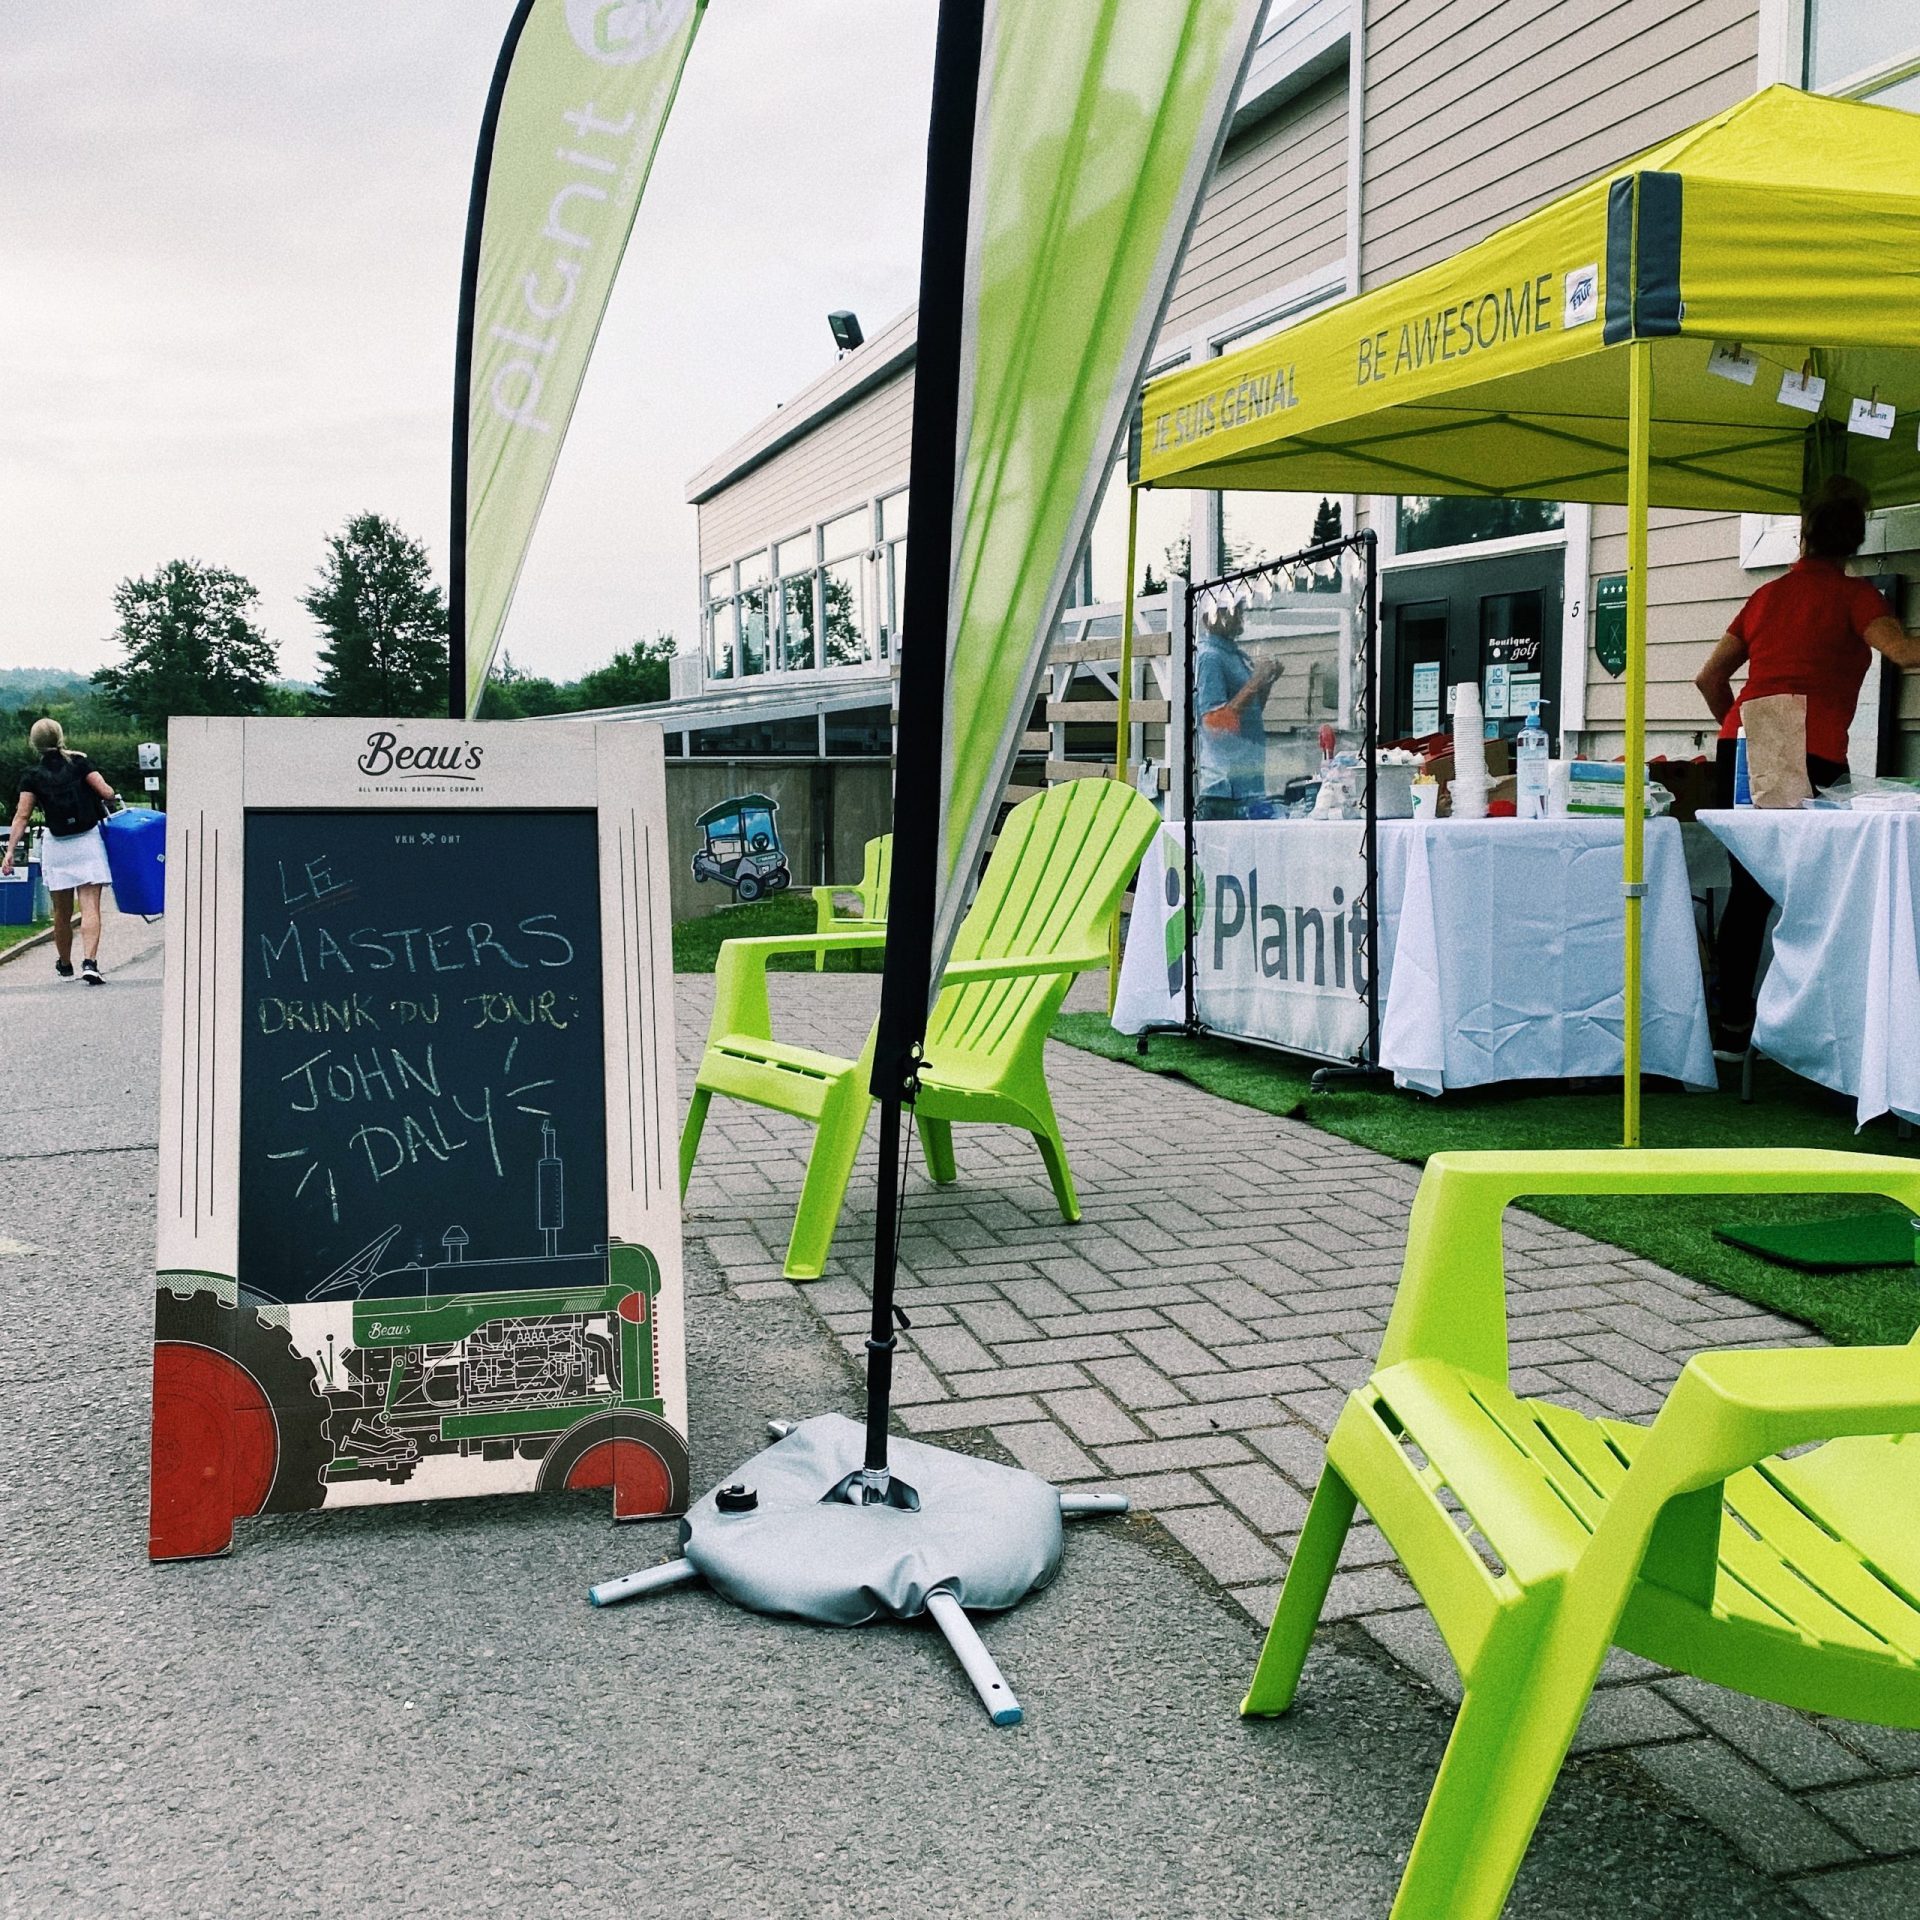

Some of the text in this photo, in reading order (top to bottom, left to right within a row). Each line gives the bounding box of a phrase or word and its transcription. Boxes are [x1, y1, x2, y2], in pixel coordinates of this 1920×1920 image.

[1358, 273, 1552, 386] BE AWESOME
[1152, 363, 1299, 456] JE SUIS GÉNIAL
[1571, 601, 1581, 618] 5
[1489, 637, 1530, 647] Boutique
[1510, 642, 1540, 660] golf
[358, 731, 484, 776] Beau's
[441, 834, 460, 844] ONT
[278, 854, 353, 904] LE
[261, 914, 574, 982] MASTERS
[258, 993, 381, 1034] DRINK
[390, 993, 440, 1024] DU
[281, 1043, 441, 1112] JOHN
[349, 1087, 504, 1182] DALY
[368, 1321, 412, 1340] Beau's
